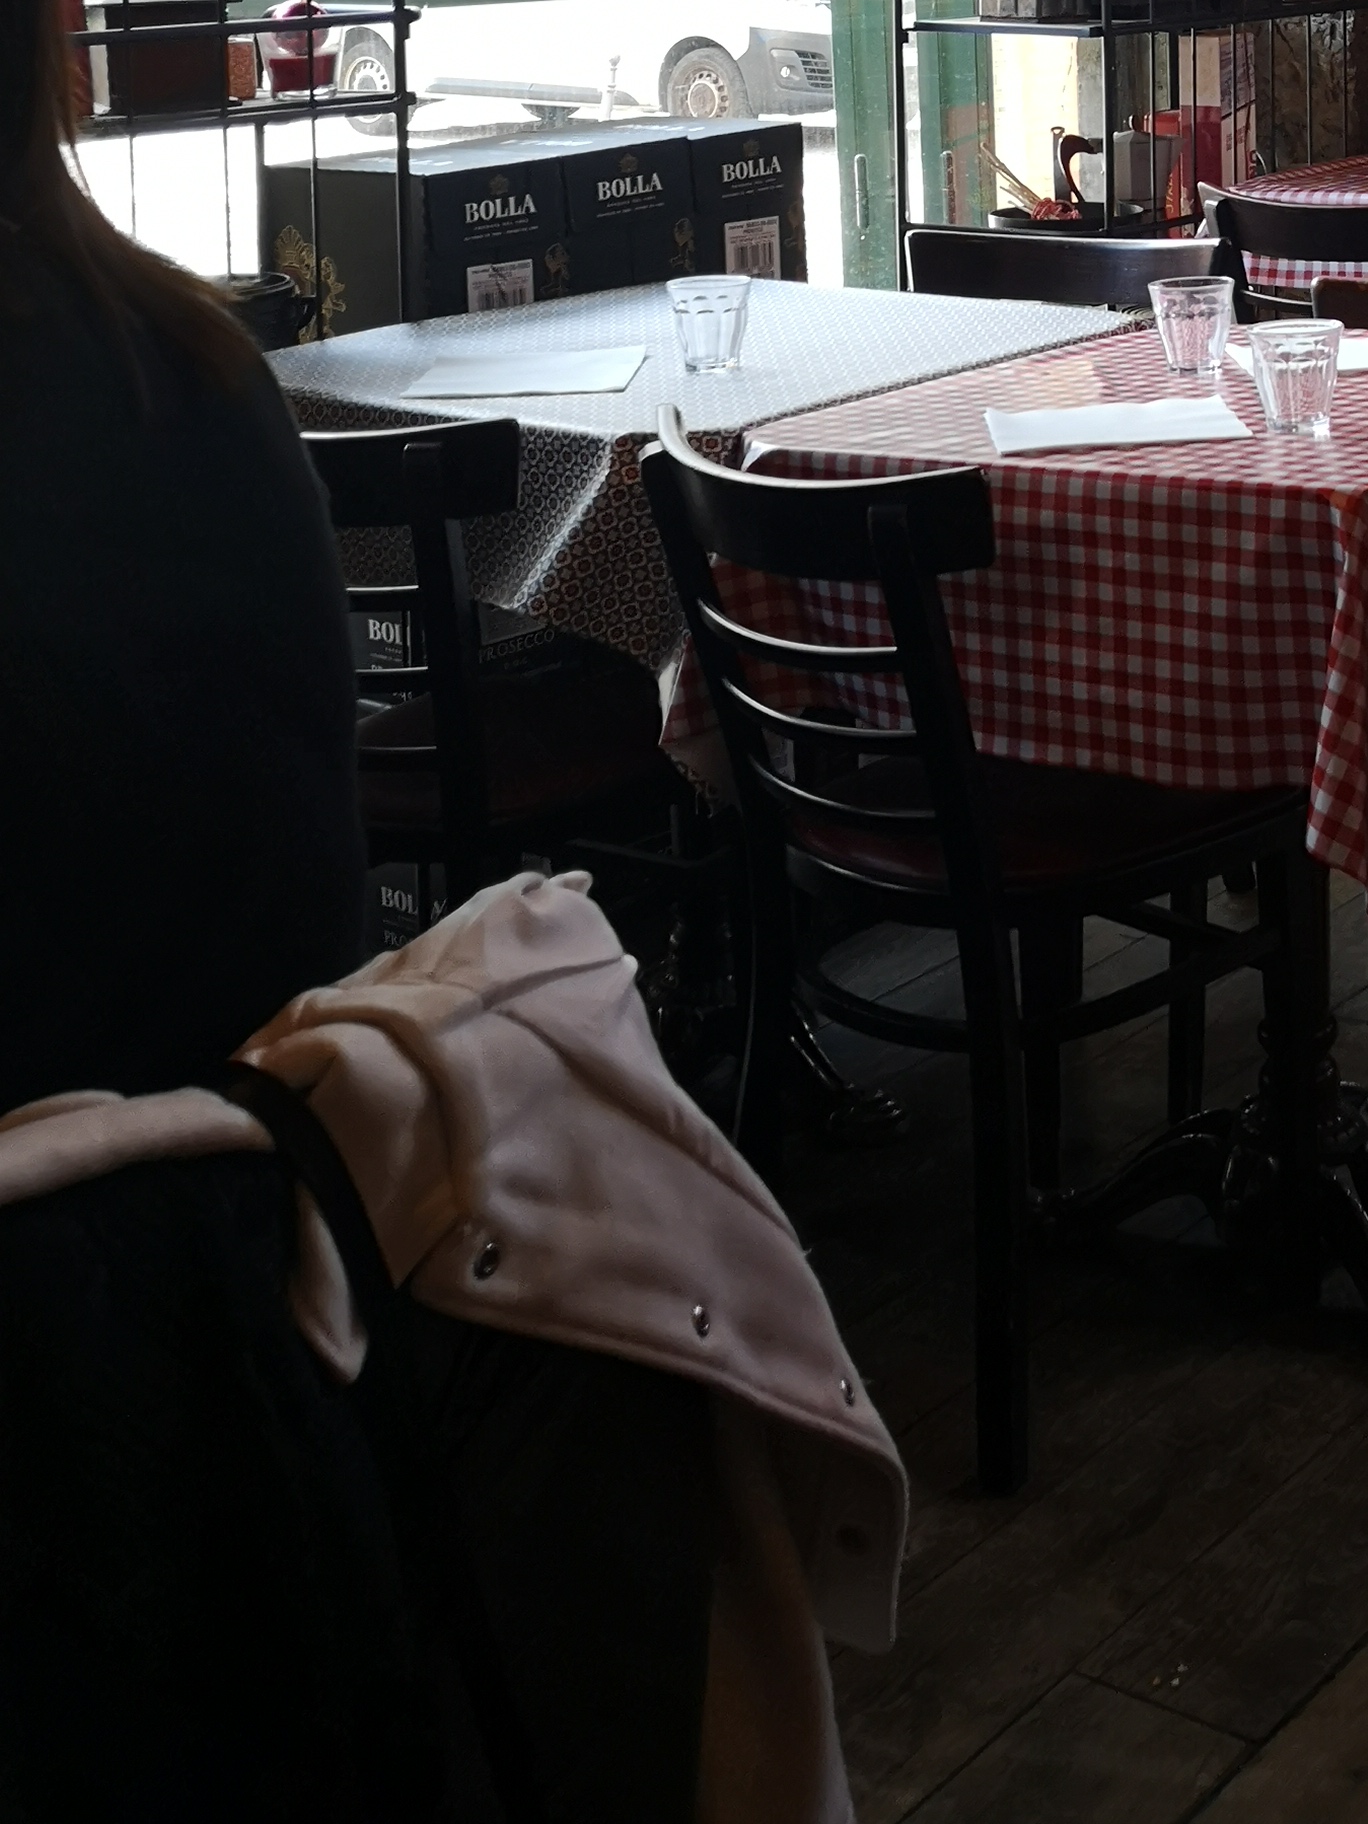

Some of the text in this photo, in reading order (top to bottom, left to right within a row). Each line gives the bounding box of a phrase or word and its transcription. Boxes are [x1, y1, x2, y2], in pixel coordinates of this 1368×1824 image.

[721, 155, 782, 184] BOLLA
[597, 172, 663, 202] BOLLA
[464, 193, 538, 225] BOLLA
